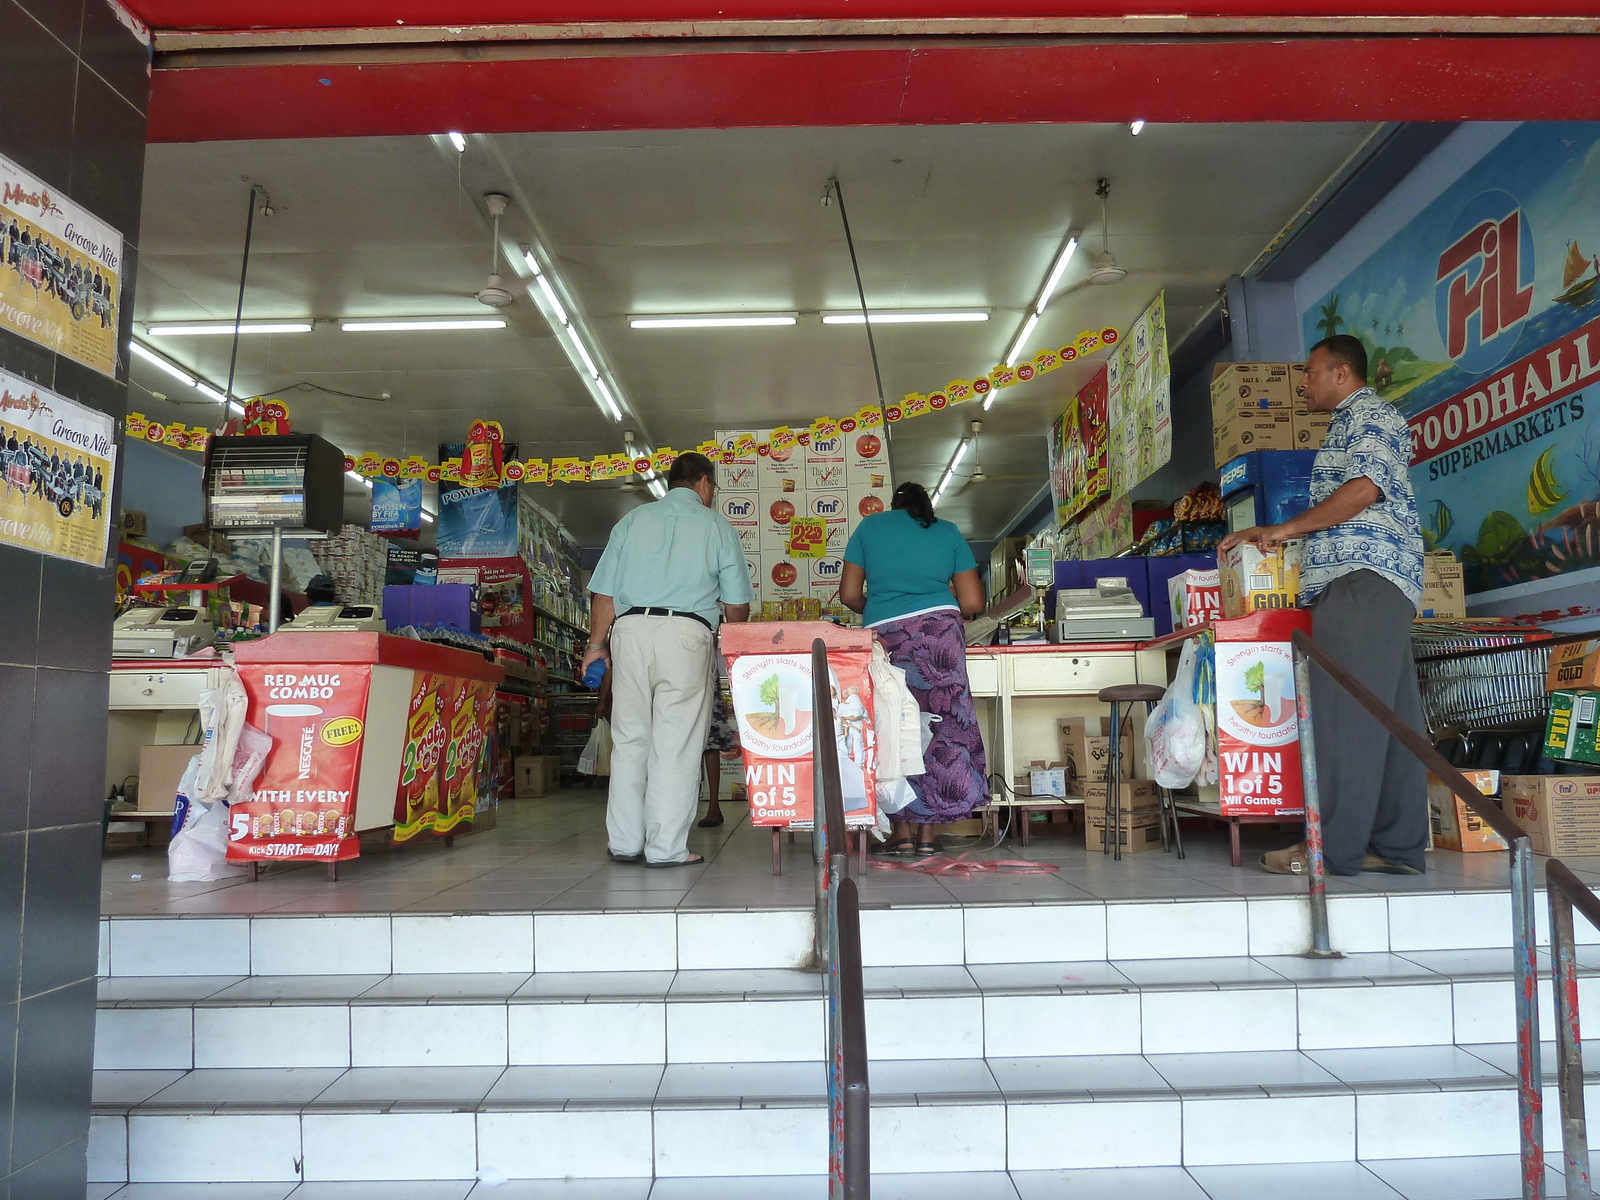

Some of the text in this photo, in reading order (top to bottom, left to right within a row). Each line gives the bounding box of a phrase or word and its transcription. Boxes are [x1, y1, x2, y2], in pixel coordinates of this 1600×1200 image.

[64, 223, 118, 268] Groove Nite
[1409, 334, 1600, 462] FOODHALL
[52, 420, 110, 456] Groove Nite
[1429, 394, 1585, 482] SUPERMARKETS
[723, 469, 735, 477] The
[811, 467, 823, 476] The
[728, 479, 750, 488] Choice
[816, 478, 838, 486] Choice
[728, 502, 751, 515] fmf
[817, 500, 839, 513] fmf
[791, 525, 822, 551] 2.29
[819, 560, 841, 574] fmf
[1227, 645, 1282, 667] Strength starts
[1562, 644, 1582, 658] FIJI
[742, 658, 774, 680] Strength
[776, 658, 797, 667] starts
[1558, 667, 1582, 681] GOLD
[264, 674, 340, 686] RED MUG
[270, 687, 334, 699] COMBO
[413, 682, 426, 710] new
[455, 686, 466, 712] new
[327, 724, 359, 739] FREE!
[1228, 716, 1257, 738] healthy
[1549, 708, 1572, 748] FIJI
[743, 730, 773, 751] healthy
[402, 741, 417, 786] 2
[445, 741, 457, 781] 2
[1224, 752, 1281, 773] WIN
[1238, 774, 1263, 794] of
[1268, 775, 1282, 793] 5
[1559, 784, 1573, 793] fmf
[250, 790, 349, 802] WITH EVERY
[753, 787, 796, 806] of 5
[1225, 796, 1282, 805] Wii Games
[758, 808, 796, 817] Games
[1515, 806, 1526, 818] UP
[231, 814, 249, 841] 5
[249, 846, 265, 854] Kick
[266, 844, 302, 855] START
[314, 844, 340, 855] DAY!
